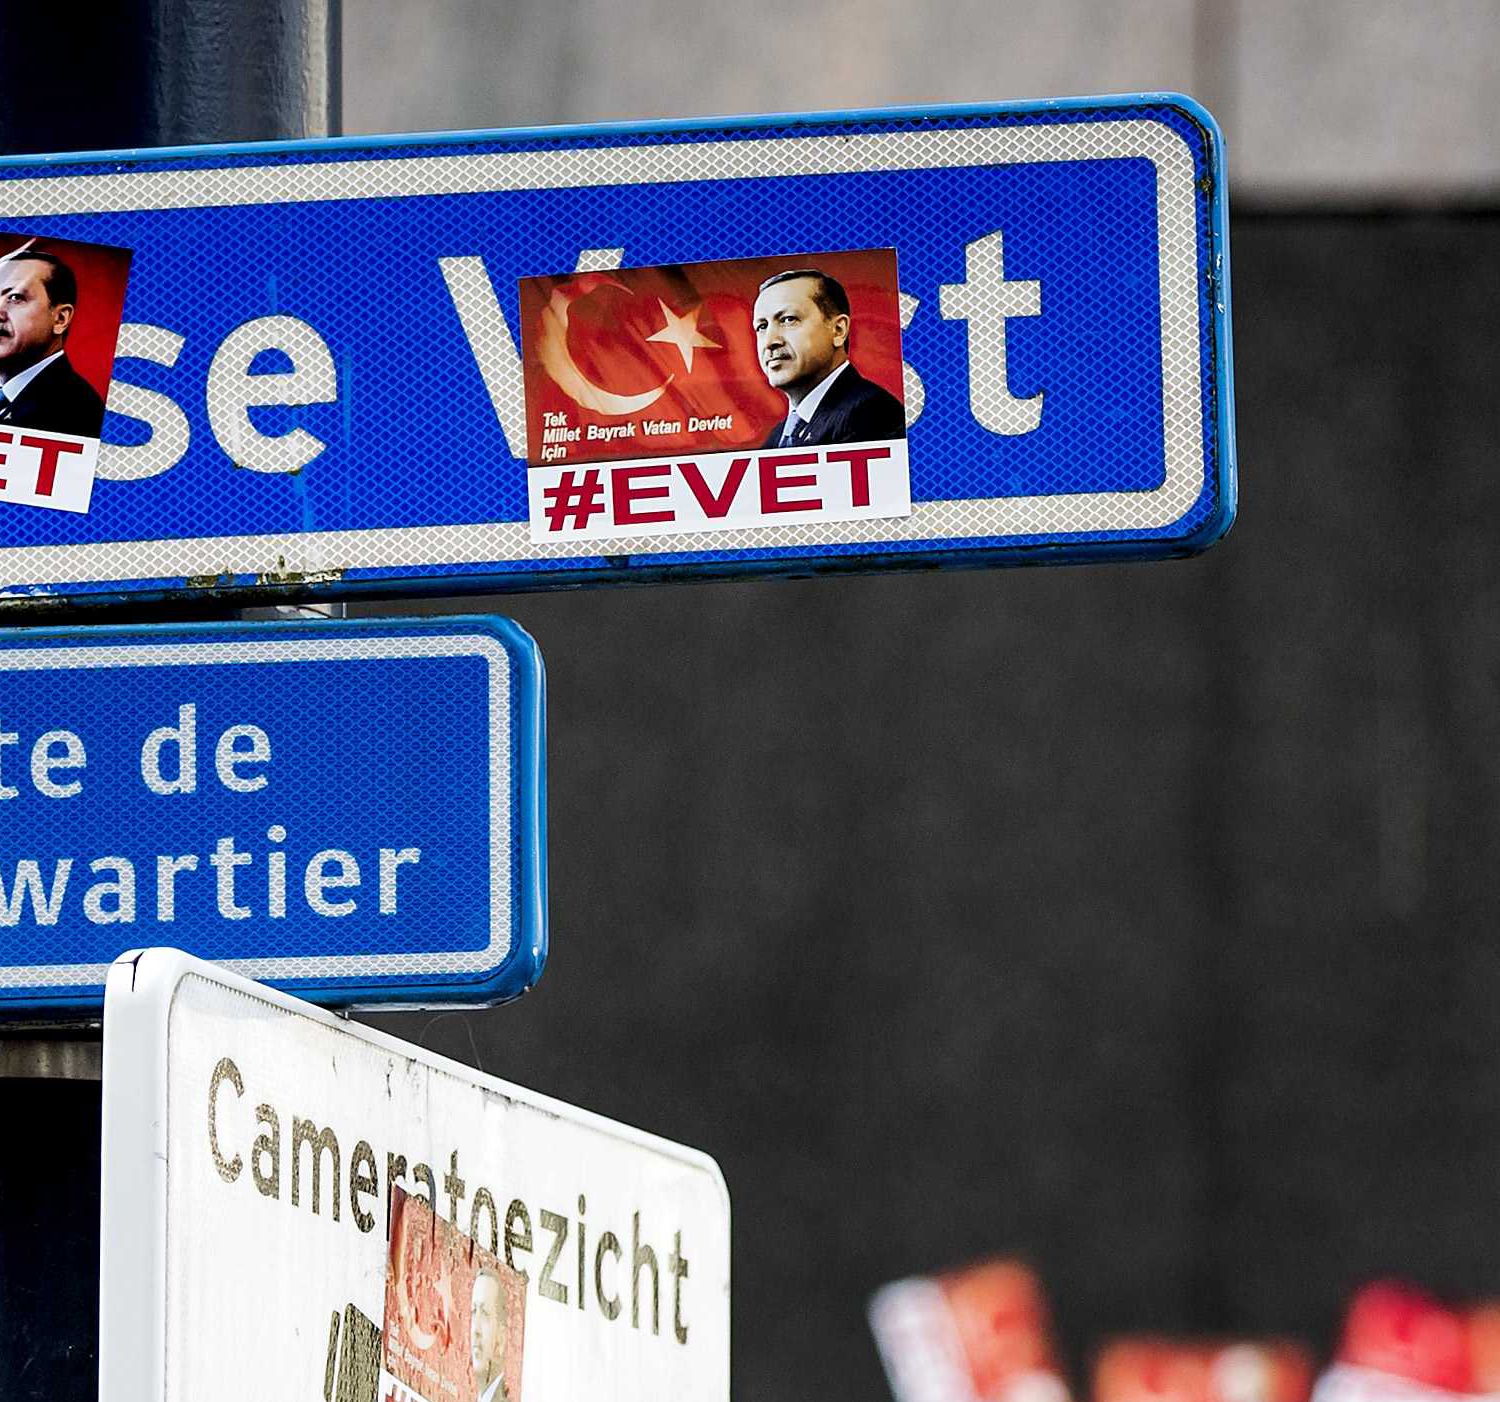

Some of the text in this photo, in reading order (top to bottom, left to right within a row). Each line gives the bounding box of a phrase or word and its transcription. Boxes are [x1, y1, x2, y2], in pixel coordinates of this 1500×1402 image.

[542, 412, 568, 428] Tek
[543, 415, 733, 444] Millet Bayrak Vatan Devlet
[543, 447, 891, 532] #EVET
[140, 703, 272, 796] de
